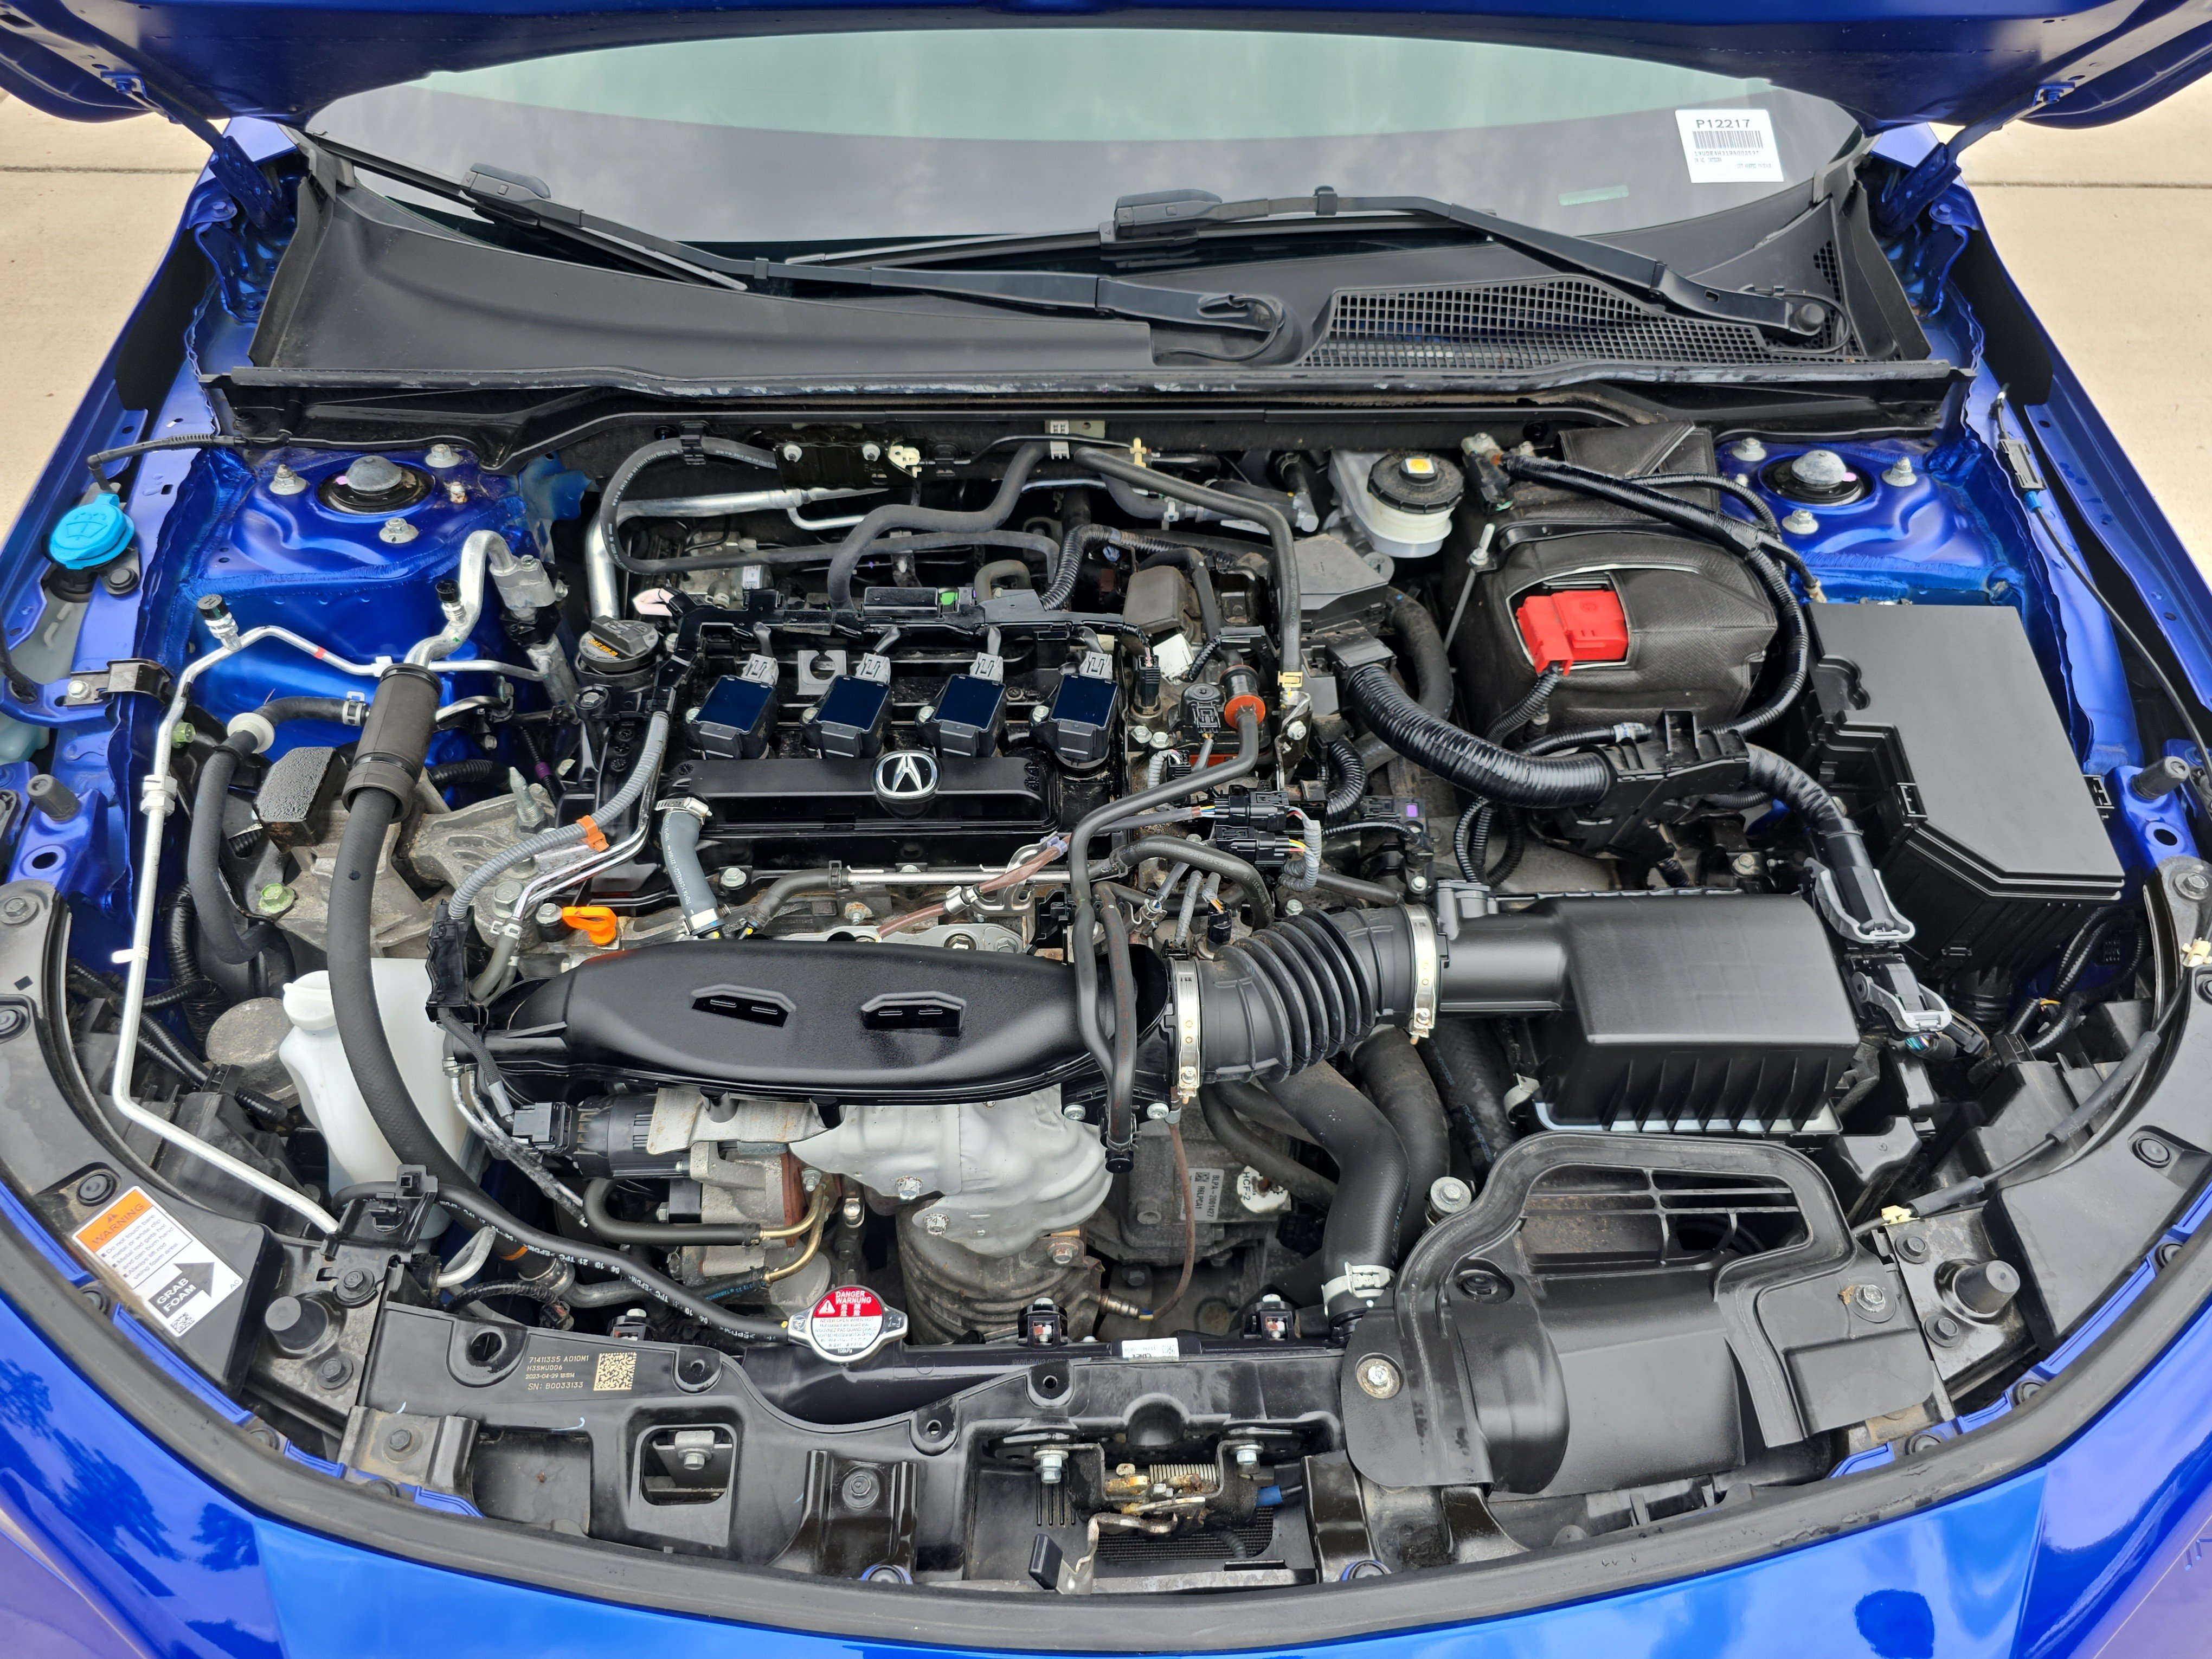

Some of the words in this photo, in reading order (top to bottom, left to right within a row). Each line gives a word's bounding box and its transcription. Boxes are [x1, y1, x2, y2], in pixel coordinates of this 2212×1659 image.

[1695, 119, 1750, 128] P12217
[588, 639, 602, 650] SAE
[1243, 1172, 1251, 1201] HCF-2
[92, 1203, 145, 1246] WARNING
[106, 1245, 115, 1255] Do
[115, 1238, 125, 1247] not
[125, 1224, 142, 1239] touch
[142, 1213, 156, 1226] bare
[111, 1245, 128, 1259] metal
[135, 1227, 151, 1240] white
[117, 1250, 134, 1265] Metal
[133, 1242, 144, 1251] rod
[144, 1232, 157, 1244] gets
[156, 1223, 166, 1233] hot
[123, 1259, 134, 1270] and
[134, 1250, 146, 1260] can
[127, 1257, 149, 1275] Always
[156, 1242, 167, 1252] rod
[133, 1265, 150, 1280] using
[150, 1253, 165, 1266] foam
[558, 1253, 576, 1263] TPC
[156, 1277, 189, 1304] GRAB
[163, 1284, 197, 1313] FOAM
[835, 1296, 872, 1305] WARNUNG
[545, 1381, 583, 1390] B0033133
